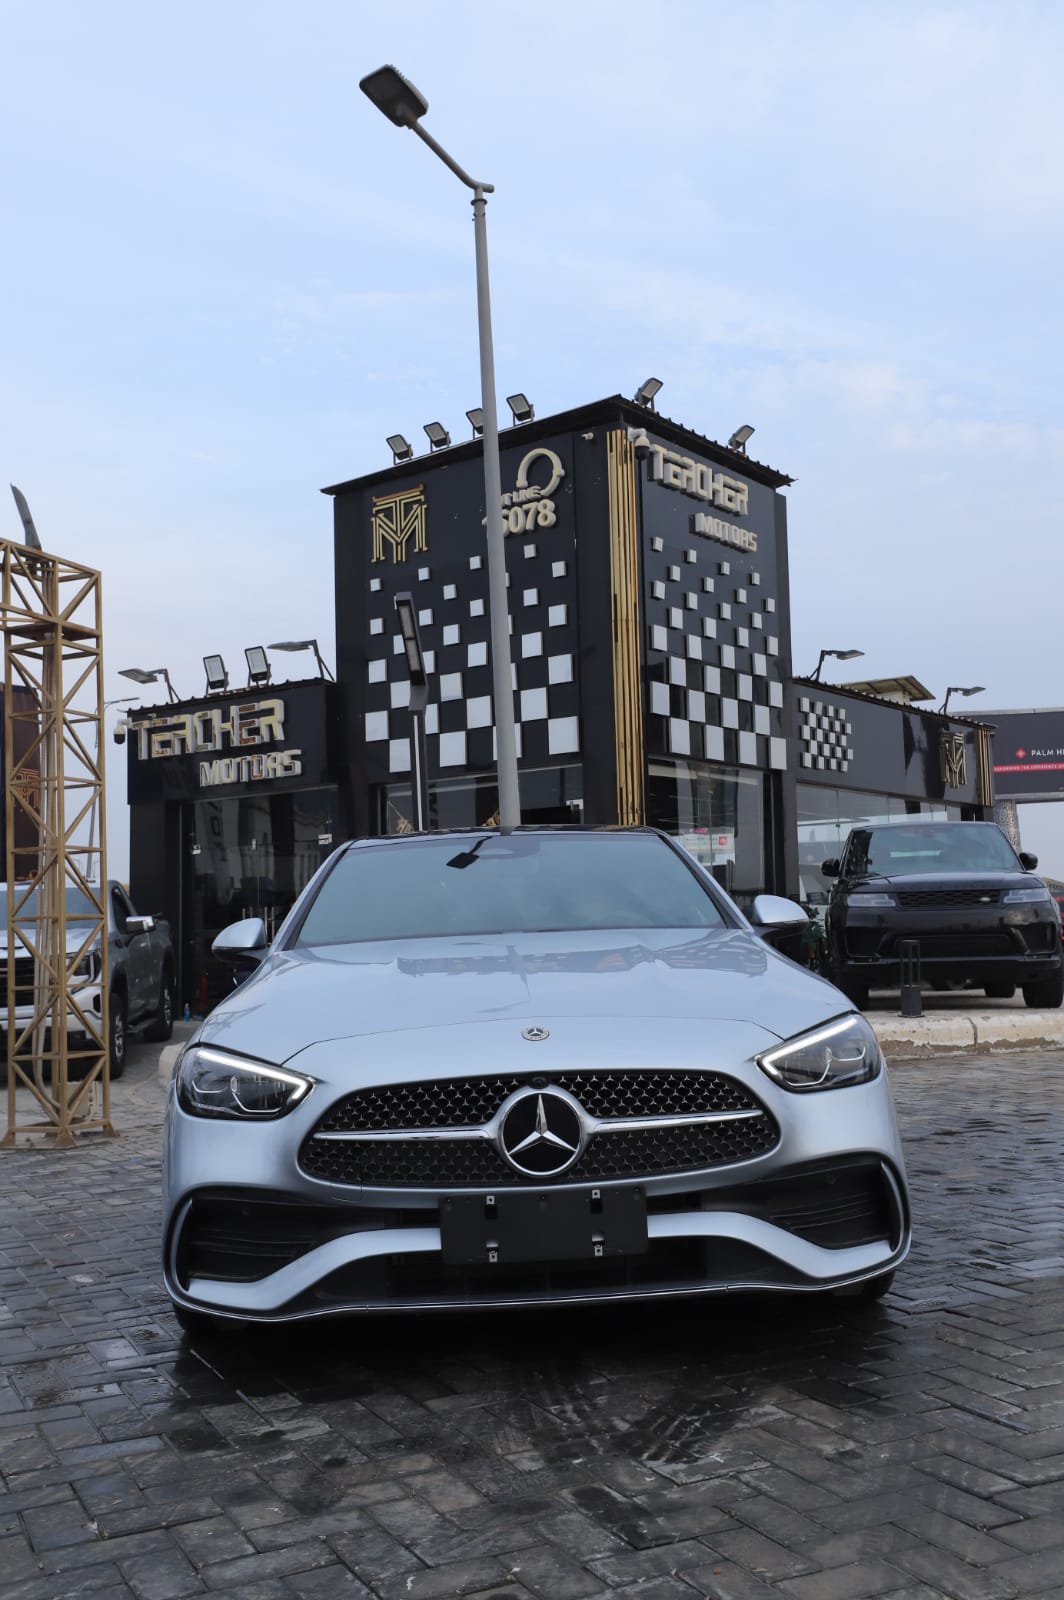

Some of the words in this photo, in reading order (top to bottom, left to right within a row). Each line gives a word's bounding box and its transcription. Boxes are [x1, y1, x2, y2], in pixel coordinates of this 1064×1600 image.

[649, 443, 748, 516] TEACHER
[694, 512, 758, 552] MOTORS
[131, 699, 285, 760] TEACHER
[199, 749, 302, 787] MOTORS
[1031, 748, 1054, 757] PALM
